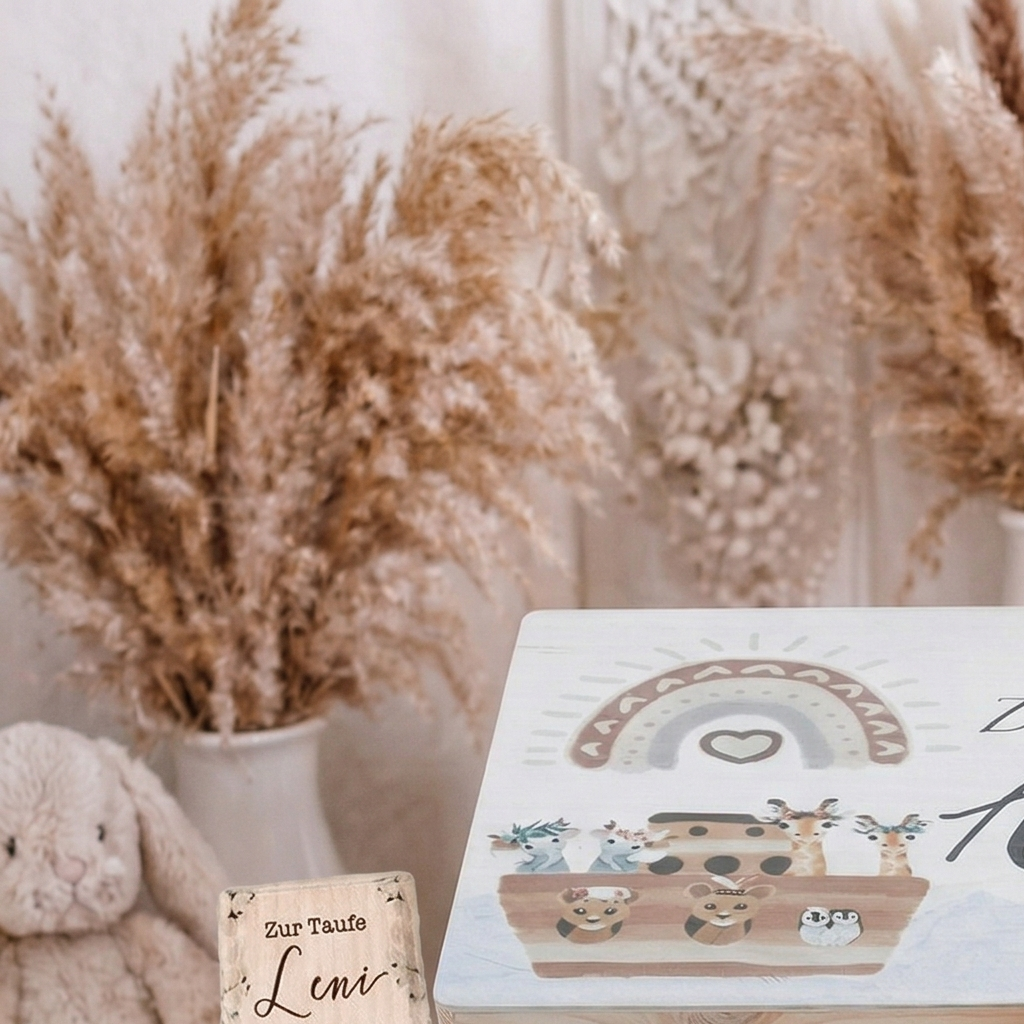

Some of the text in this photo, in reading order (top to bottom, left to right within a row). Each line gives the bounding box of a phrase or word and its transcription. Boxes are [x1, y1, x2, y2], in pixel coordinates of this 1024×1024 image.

[264, 914, 367, 939] Zur Taufe
[254, 944, 389, 1019] Leni
